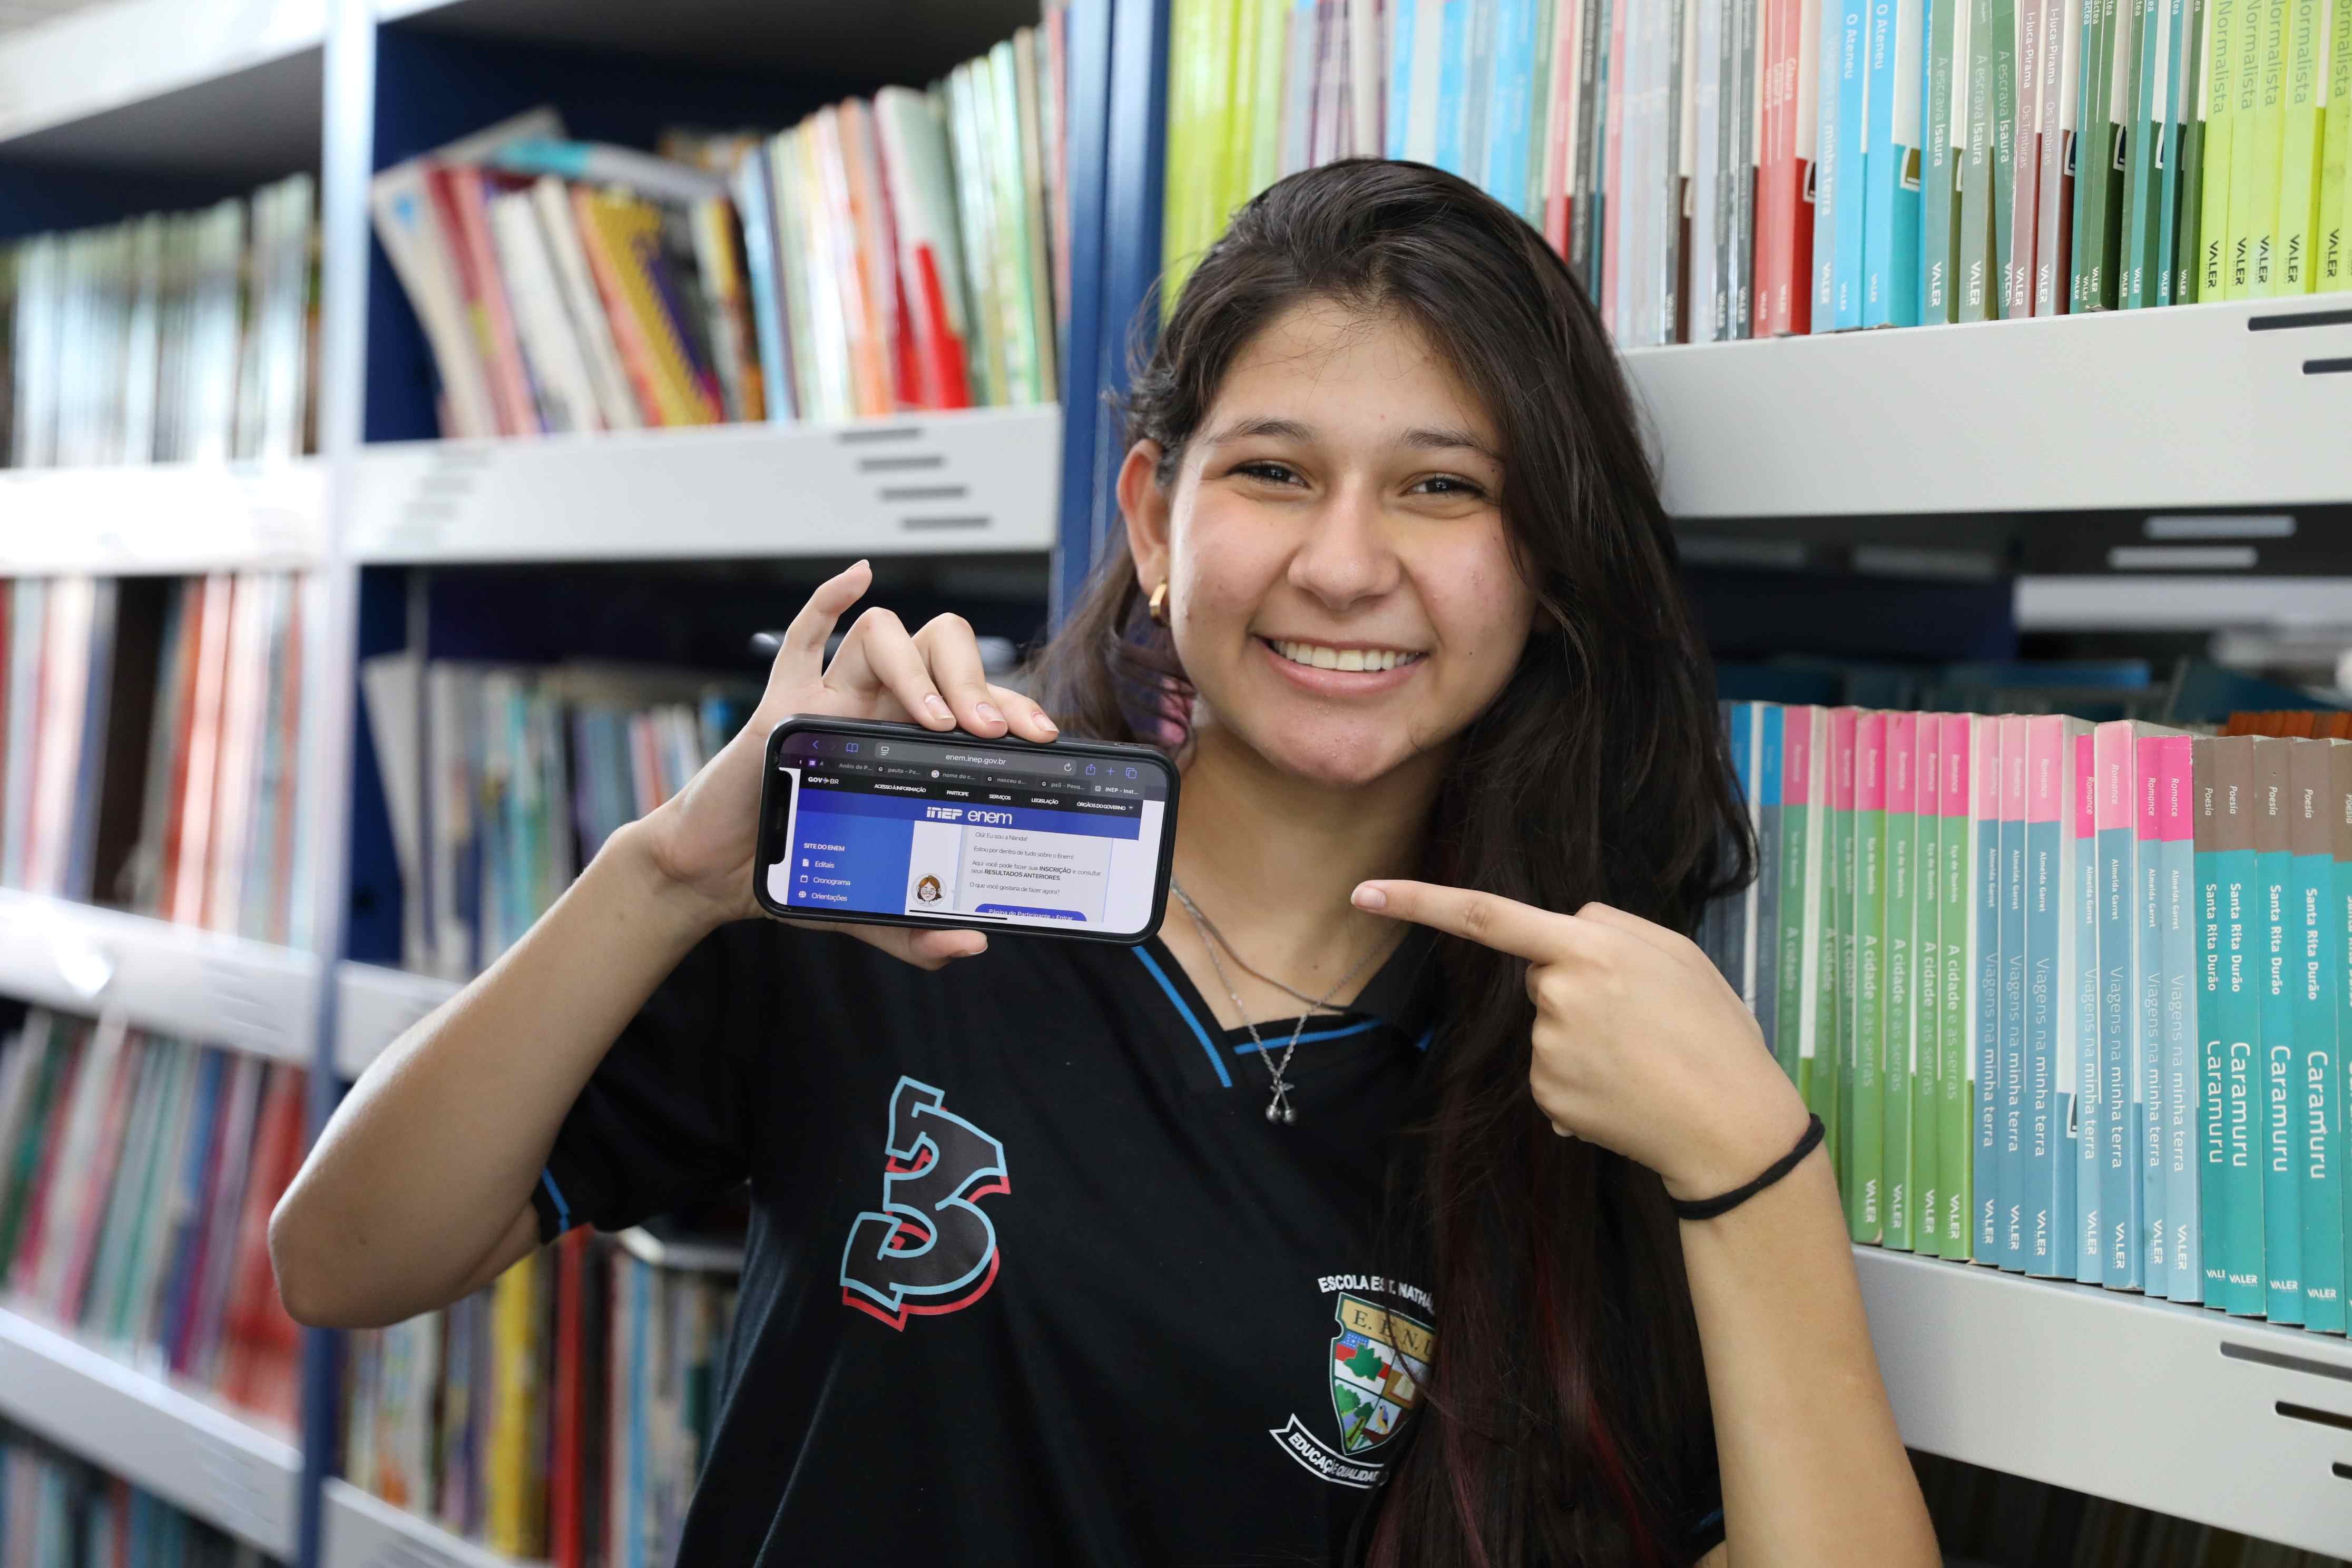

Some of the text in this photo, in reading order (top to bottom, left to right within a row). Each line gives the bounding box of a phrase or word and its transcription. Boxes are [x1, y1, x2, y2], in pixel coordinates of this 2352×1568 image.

[1844, 14, 1858, 79] O Ateneu
[1874, 4, 1888, 69] O Ateneu
[2213, 1, 2233, 114] Normalista
[2295, 0, 2312, 104] ormalista
[1934, 57, 1948, 166] A escrava Isaura
[1973, 55, 1988, 165] A escrava Isaura
[1998, 51, 2011, 163] A escrava Isaura
[2020, 105, 2031, 169] Os Timbiras
[2044, 102, 2055, 165] Os Timbiras
[2208, 240, 2219, 288] VALER
[2258, 235, 2269, 284] VALER
[2288, 234, 2300, 283] VALER
[2327, 228, 2339, 278] VALER
[1932, 261, 1942, 307] VALER
[1970, 260, 1981, 306] VALER
[2015, 267, 2024, 306] VALER
[2040, 263, 2049, 304] VALER
[946, 754, 1006, 765] enem.inep.gov.br
[968, 810, 1012, 825] enem
[2269, 786, 2278, 816] Poesia
[2305, 789, 2314, 818] Poesia
[813, 877, 851, 886] Cronograma
[1039, 866, 1071, 874] INSCRIÇÃO
[811, 893, 847, 902] Orientações
[1948, 945, 1960, 955] A
[2207, 883, 2219, 991] Santa Rita Durão
[2230, 883, 2242, 992] Santa Rita Durão
[2270, 885, 2282, 995] Santa Rita Durão
[2306, 888, 2319, 1000] Santa Rita Durão
[1948, 960, 1960, 1010] cidade
[1948, 1032, 1957, 1046] as
[2033, 958, 2050, 1157] Viagens na minha terra
[1948, 1051, 1957, 1099] serras
[2169, 975, 2186, 1172] Viagens na minha terra
[2231, 1042, 2251, 1167] Caramuru
[2270, 1045, 2291, 1171] Caramuru
[2307, 1051, 2328, 1178] Caramuru
[1866, 1179, 1876, 1223] VALER
[1949, 1194, 1960, 1239] VALER
[2037, 1209, 2046, 1256] VALER
[2153, 1219, 2162, 1265] VALER
[2177, 1224, 2187, 1270] VALER
[1318, 1275, 1369, 1293] ESCOLA
[2207, 1269, 2226, 1278] VALE
[2229, 1275, 2258, 1283] VALER
[2270, 1280, 2298, 1290] VALER
[2307, 1289, 2337, 1298] VALER
